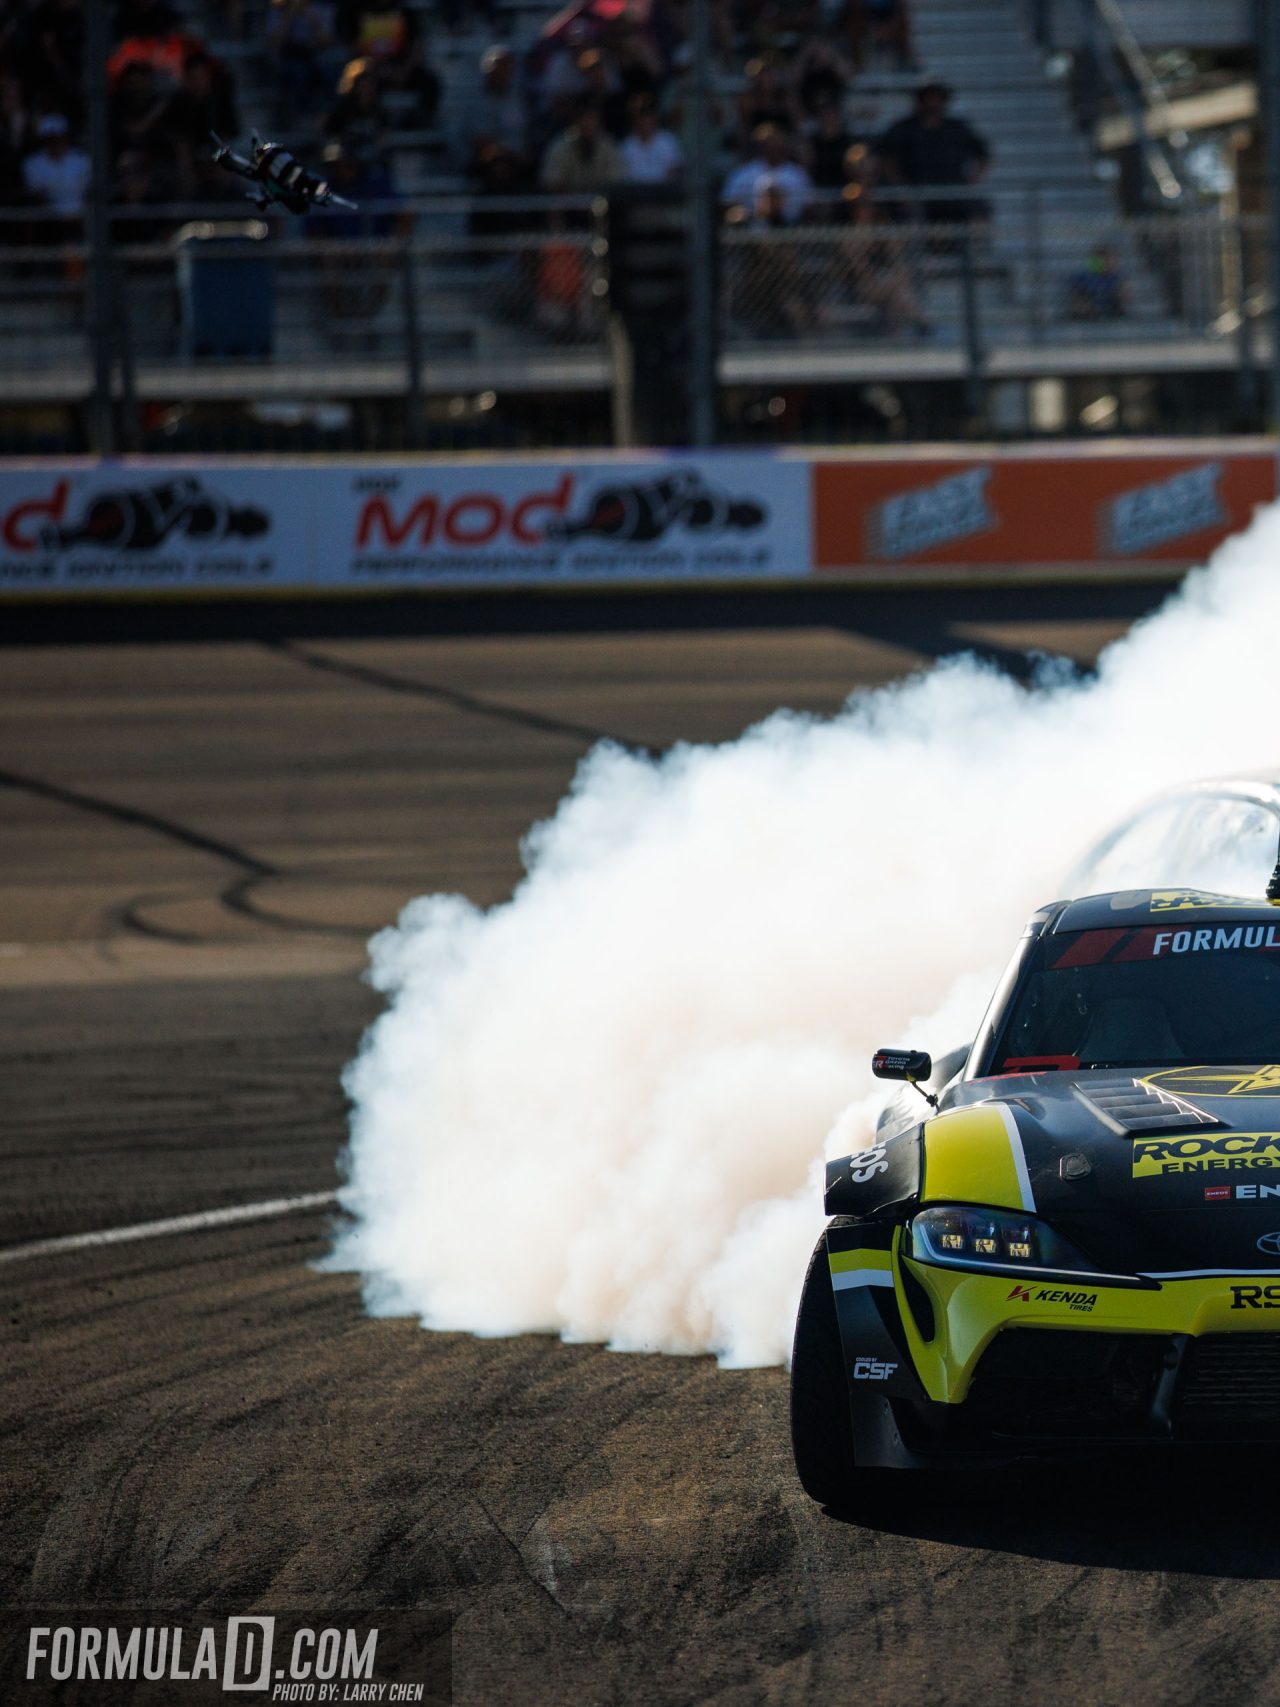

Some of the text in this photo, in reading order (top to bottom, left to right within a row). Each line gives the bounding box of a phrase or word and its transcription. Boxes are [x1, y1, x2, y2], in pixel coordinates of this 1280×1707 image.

[1035, 1290, 1098, 1306] KENDA
[1069, 1303, 1094, 1312] TIRES
[853, 1363, 898, 1380] CSF
